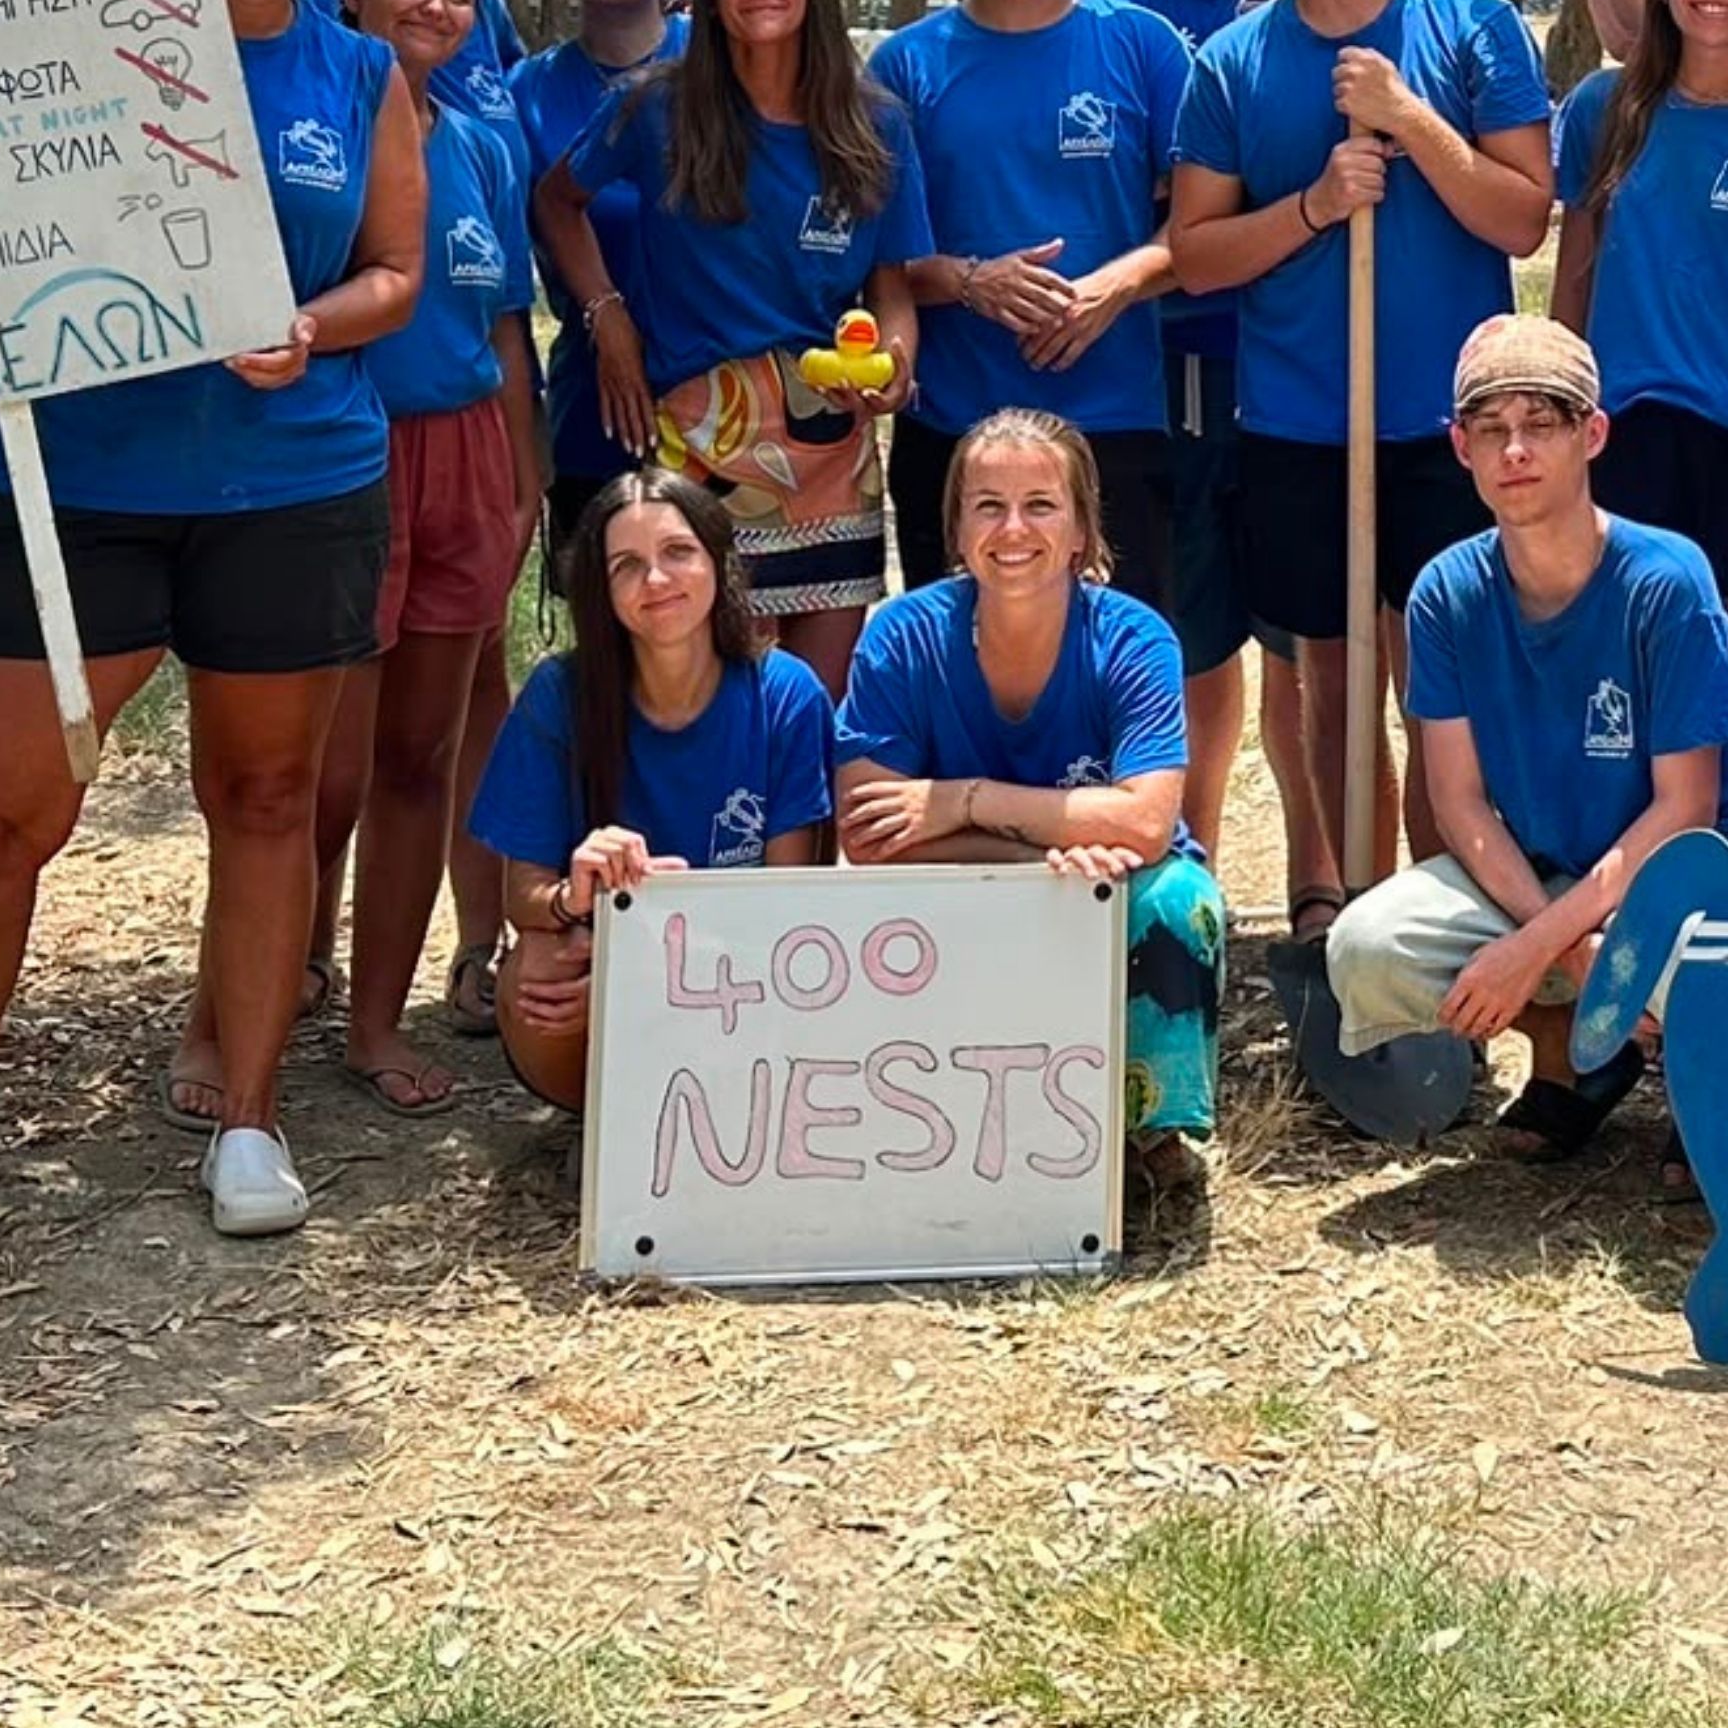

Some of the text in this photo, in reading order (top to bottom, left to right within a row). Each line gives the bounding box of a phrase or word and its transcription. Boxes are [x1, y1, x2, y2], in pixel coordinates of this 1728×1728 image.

[41, 98, 127, 131] NIGHT
[9, 133, 122, 183] ΣΚΥΛΙΑ
[663, 913, 938, 1034] 400
[650, 1041, 1107, 1199] NESTS
